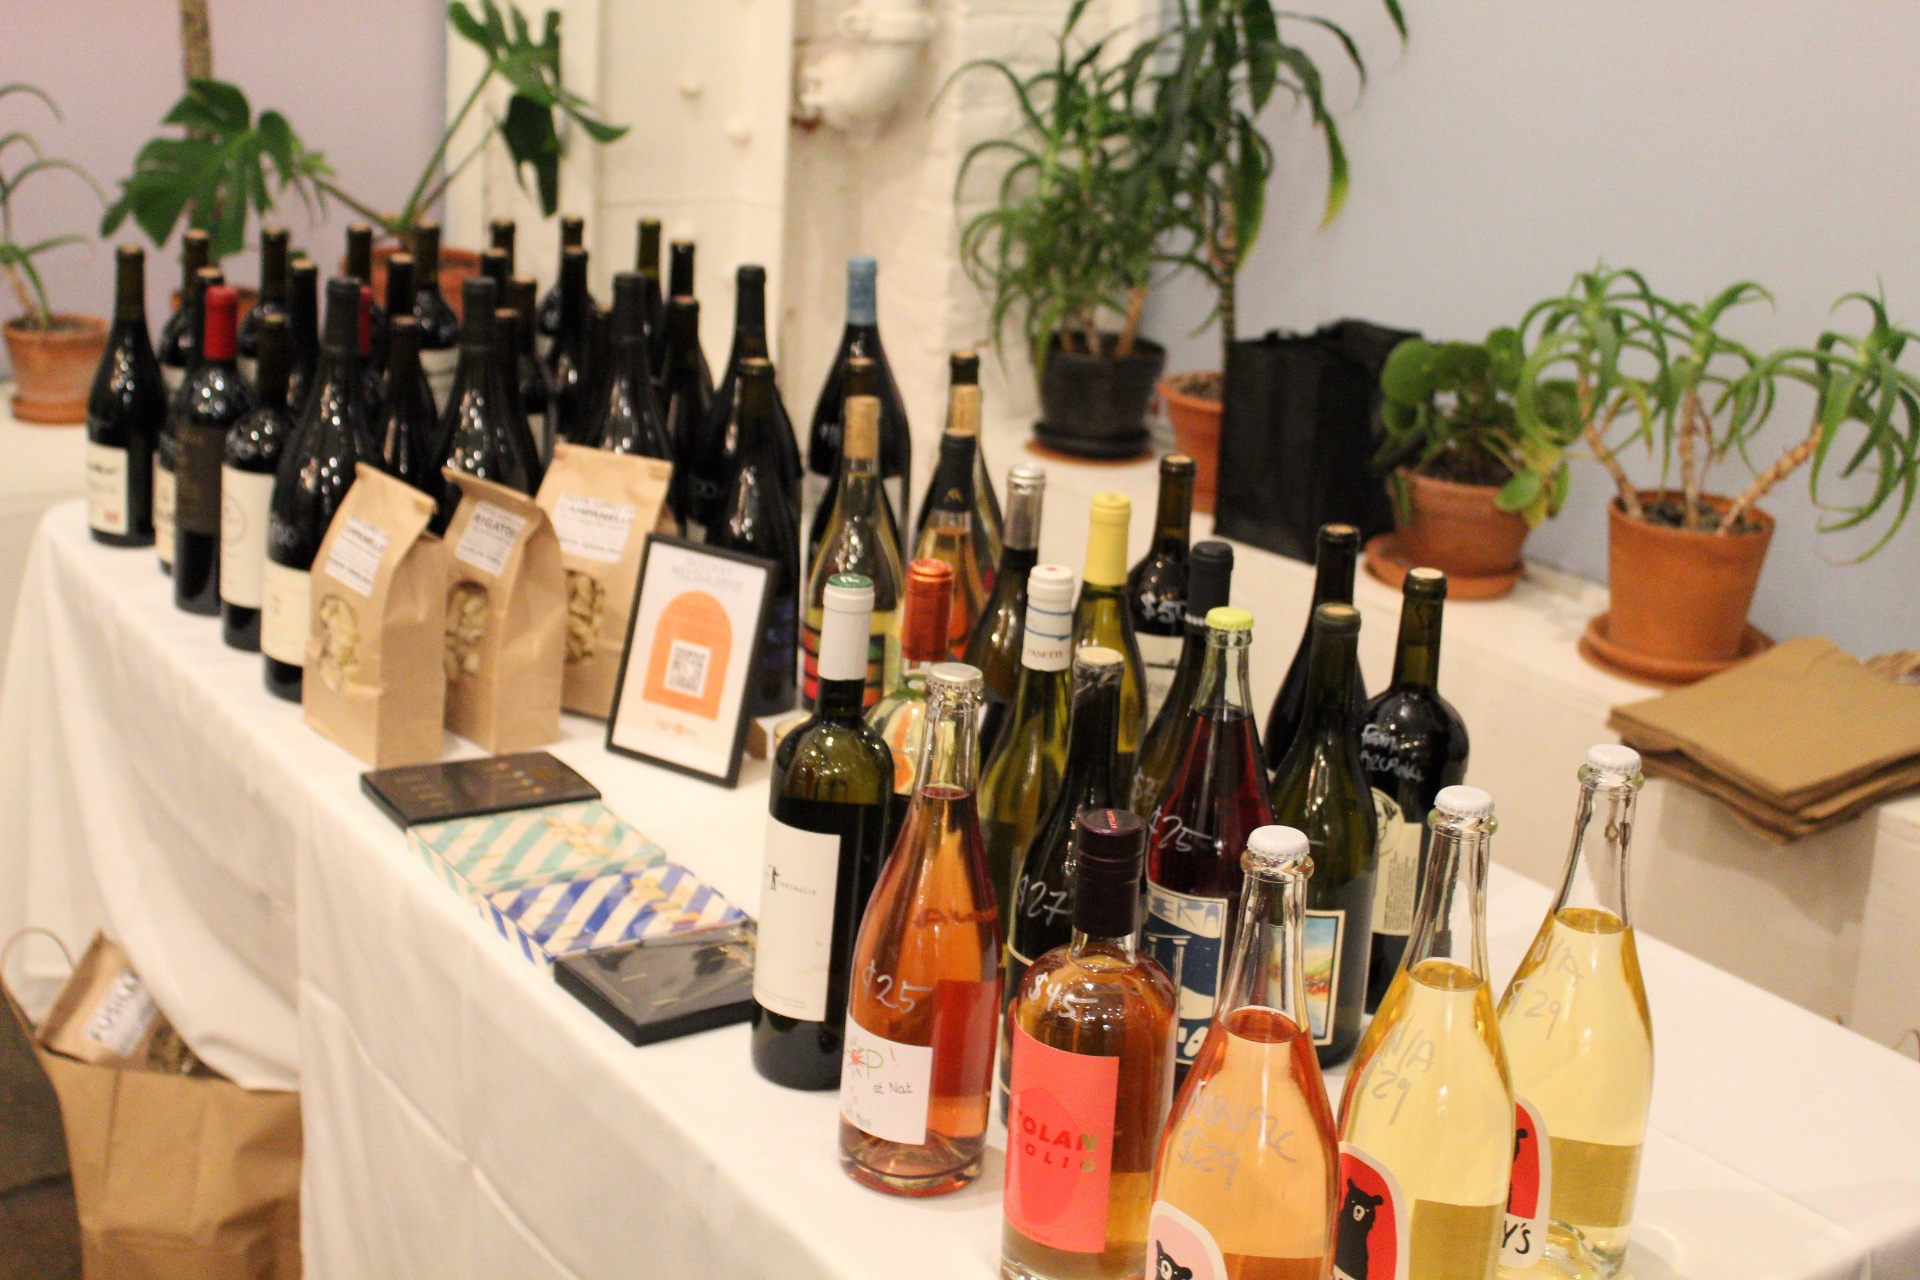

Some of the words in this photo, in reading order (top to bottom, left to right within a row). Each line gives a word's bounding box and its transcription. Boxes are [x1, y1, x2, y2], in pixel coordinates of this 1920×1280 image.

[1148, 804, 1216, 852] $25
[1016, 872, 1073, 927] $27
[861, 958, 934, 1014] $25
[1028, 972, 1099, 1018] $45
[1508, 976, 1563, 1042] $29
[888, 1081, 914, 1094] Nat
[1177, 1122, 1241, 1192] $29
